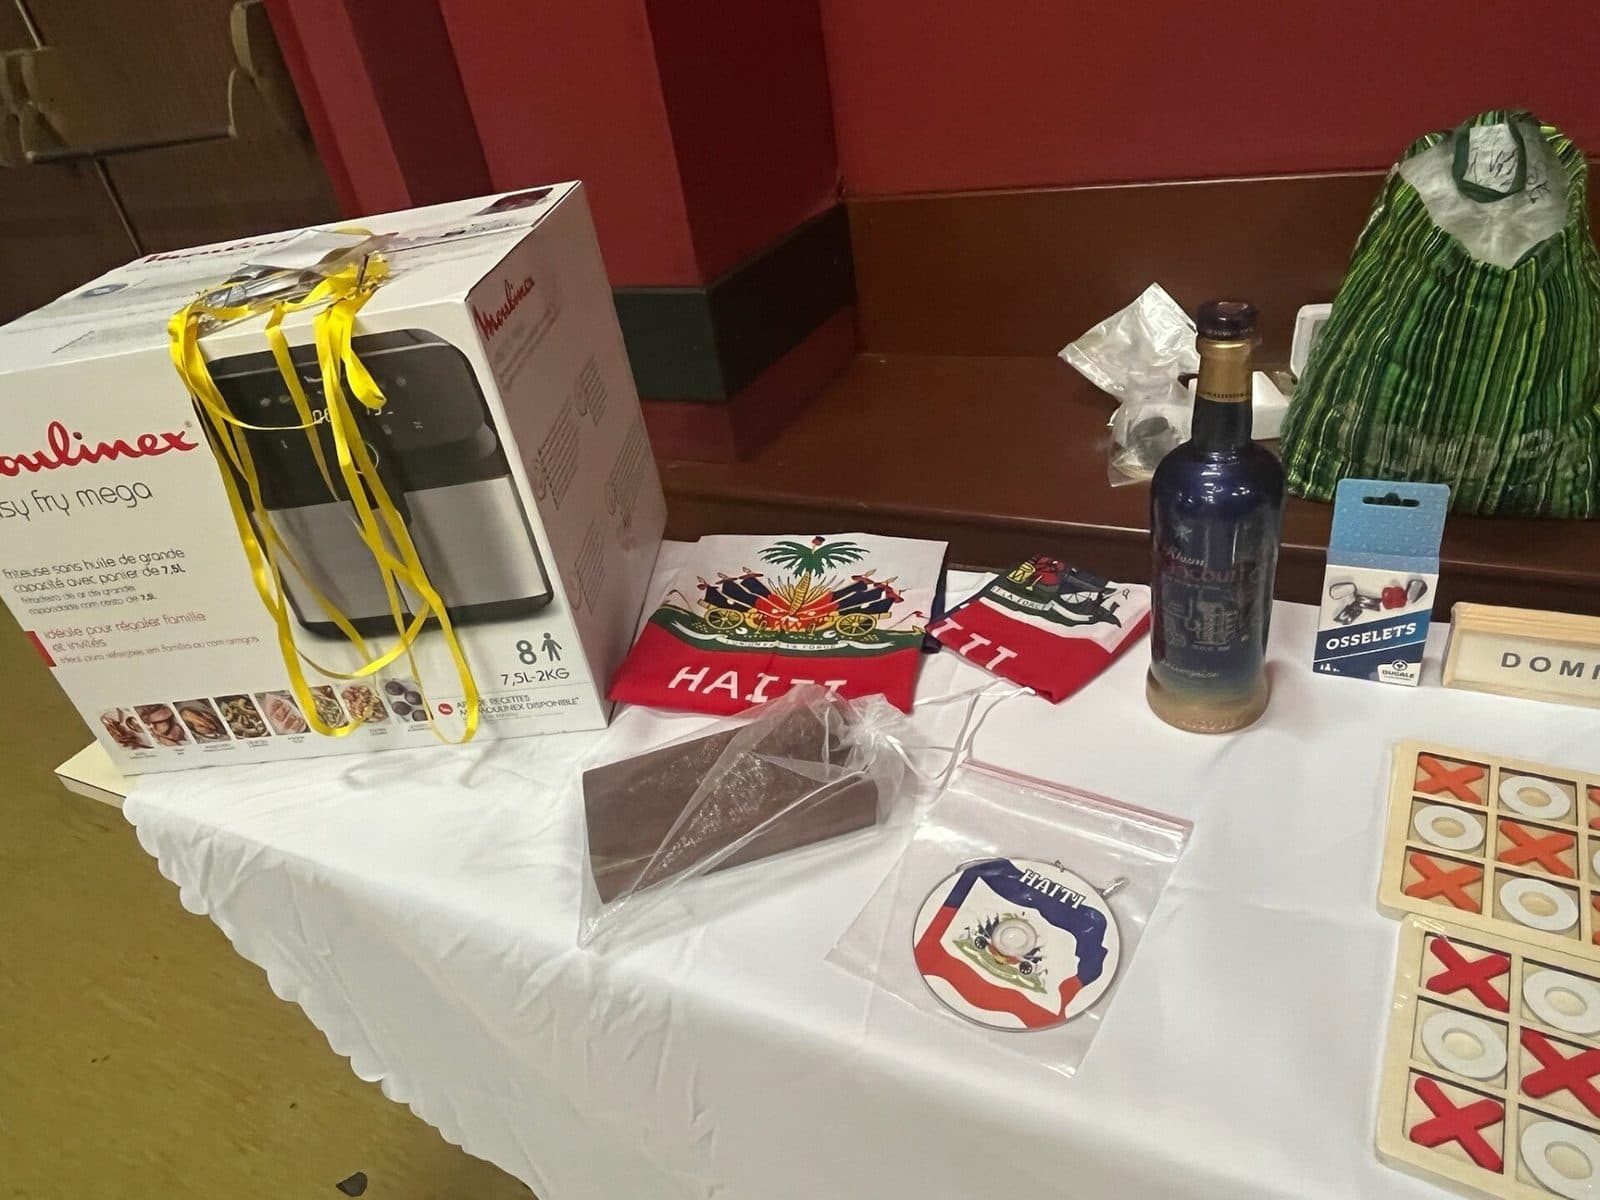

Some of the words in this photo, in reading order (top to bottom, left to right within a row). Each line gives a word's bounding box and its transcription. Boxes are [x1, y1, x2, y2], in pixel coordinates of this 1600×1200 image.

[31, 490, 71, 517] fry
[76, 482, 154, 509] mega
[82, 557, 116, 571] huile
[119, 553, 137, 565] de
[139, 547, 186, 566] grande
[67, 575, 97, 588] avec
[99, 570, 138, 586] panier
[142, 565, 161, 577] de
[163, 611, 206, 626] famille
[1325, 622, 1417, 651] OSSELETS
[515, 639, 537, 665] 8
[500, 668, 570, 687] 7,5L-2KG
[667, 665, 848, 704] HAII
[1018, 868, 1087, 910] HAITI
